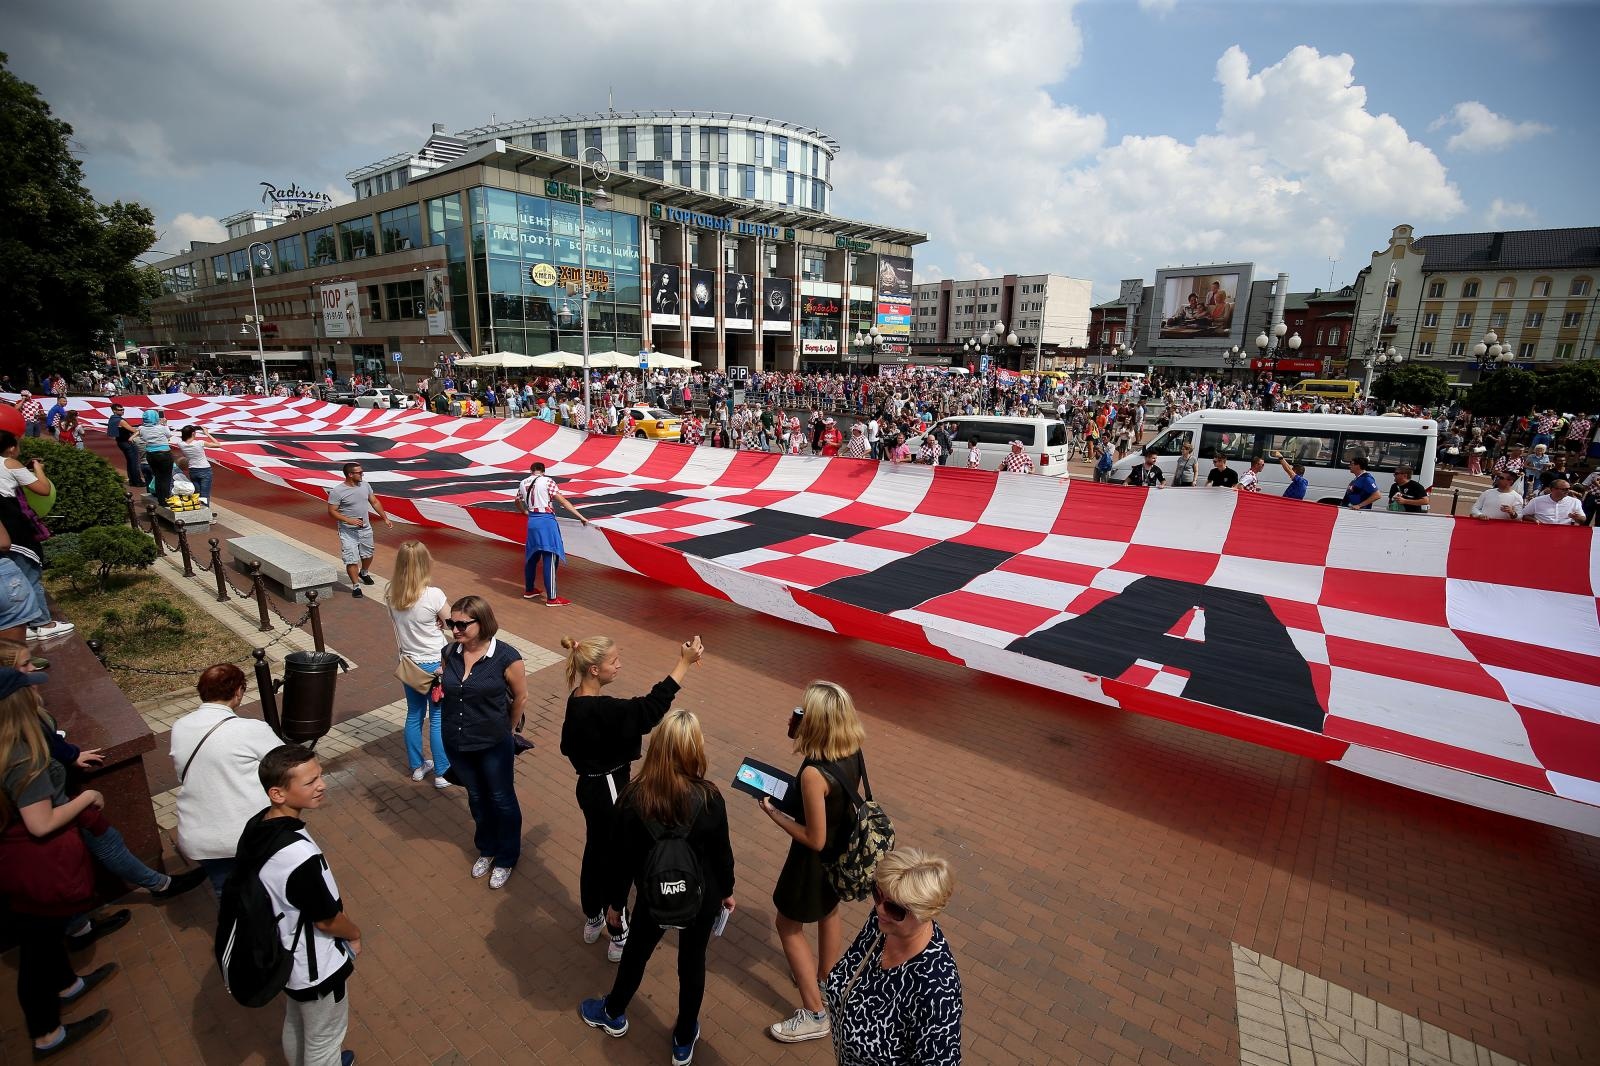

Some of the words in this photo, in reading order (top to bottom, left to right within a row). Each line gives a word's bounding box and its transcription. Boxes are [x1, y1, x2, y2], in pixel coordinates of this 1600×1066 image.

[260, 182, 332, 204] Radisson
[520, 213, 560, 228] ЦЕНТР
[667, 207, 732, 232] ТОРГОВЫЙ
[738, 220, 780, 238] ЦЕНТР
[493, 229, 561, 247] ПАСПОРТА
[534, 271, 556, 281] ХМЕЛЬ
[560, 266, 609, 284] ХМЕЛЬ
[731, 368, 737, 378] P
[740, 368, 746, 378] P
[660, 879, 686, 894] VANS
